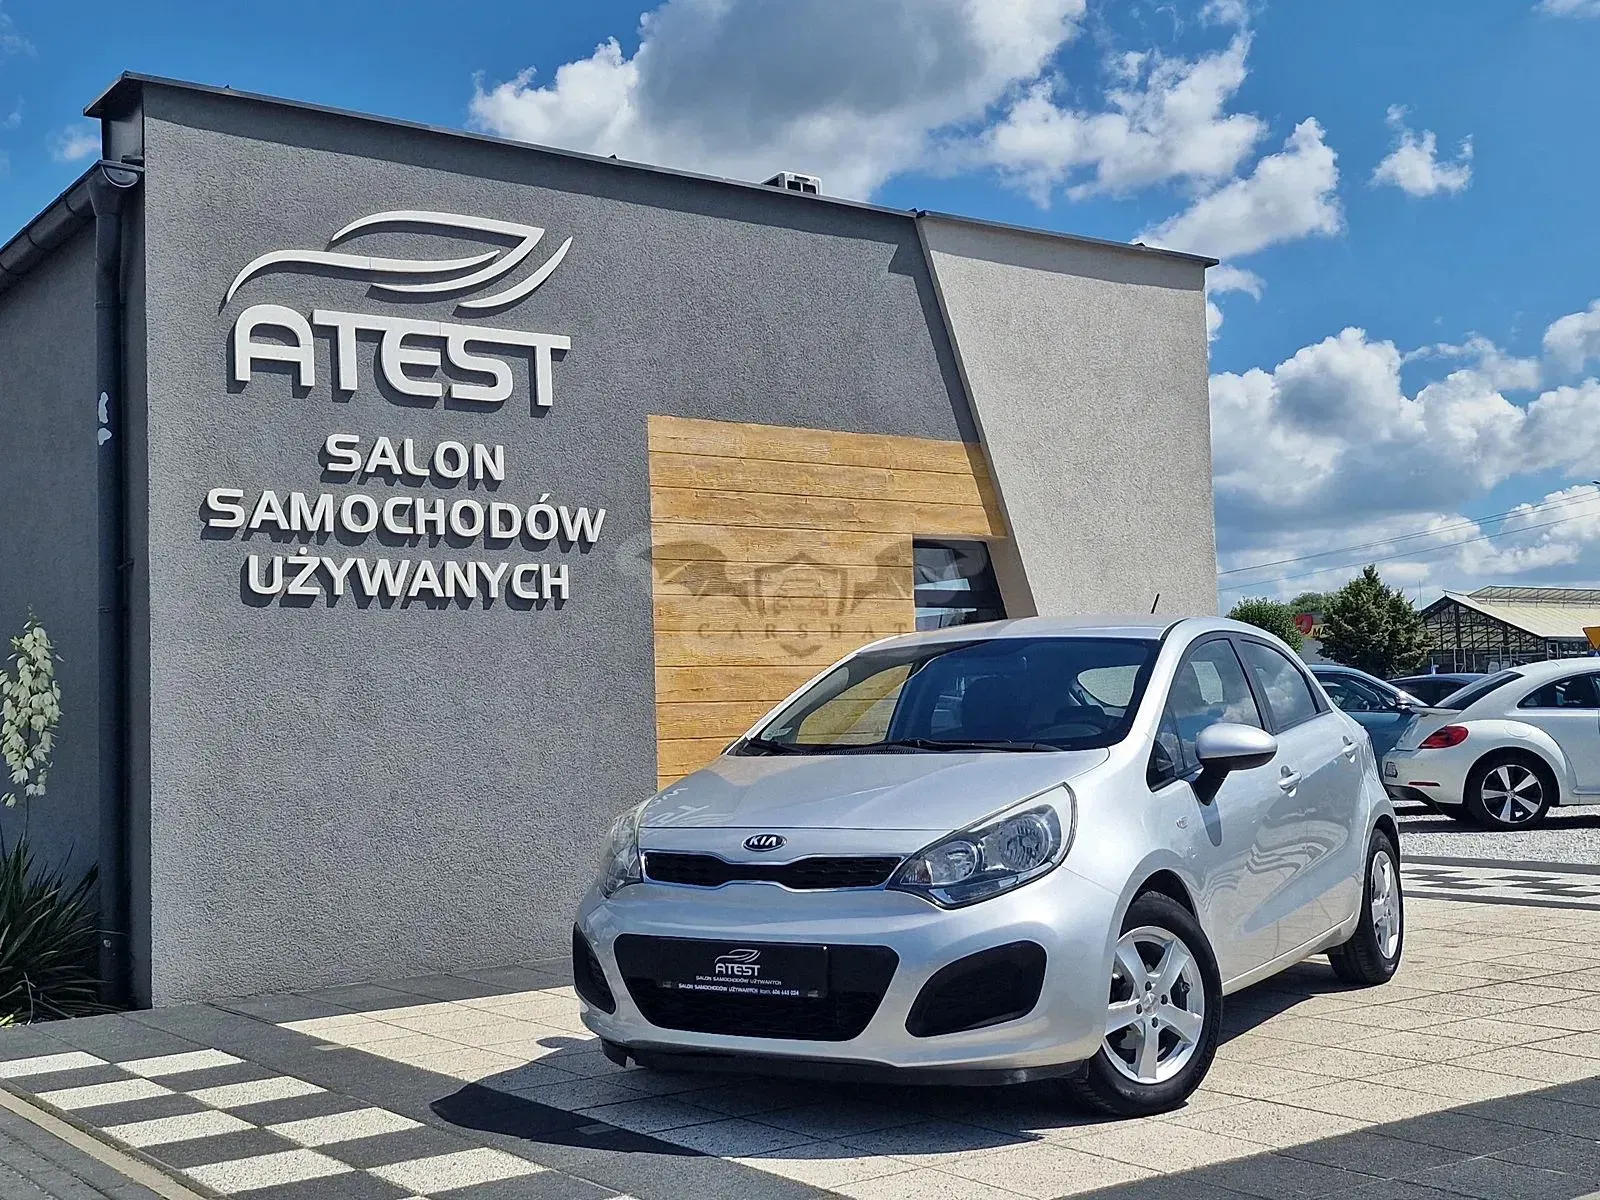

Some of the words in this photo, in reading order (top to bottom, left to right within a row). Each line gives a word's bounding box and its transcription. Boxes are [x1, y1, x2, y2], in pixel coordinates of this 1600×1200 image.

[234, 304, 571, 407] ATEST
[325, 433, 505, 481] SALON
[207, 487, 606, 543] SAMOCHODÓW
[247, 547, 570, 600] UŻYWANYCH
[749, 836, 777, 846] KIA
[715, 963, 760, 976] ATEST
